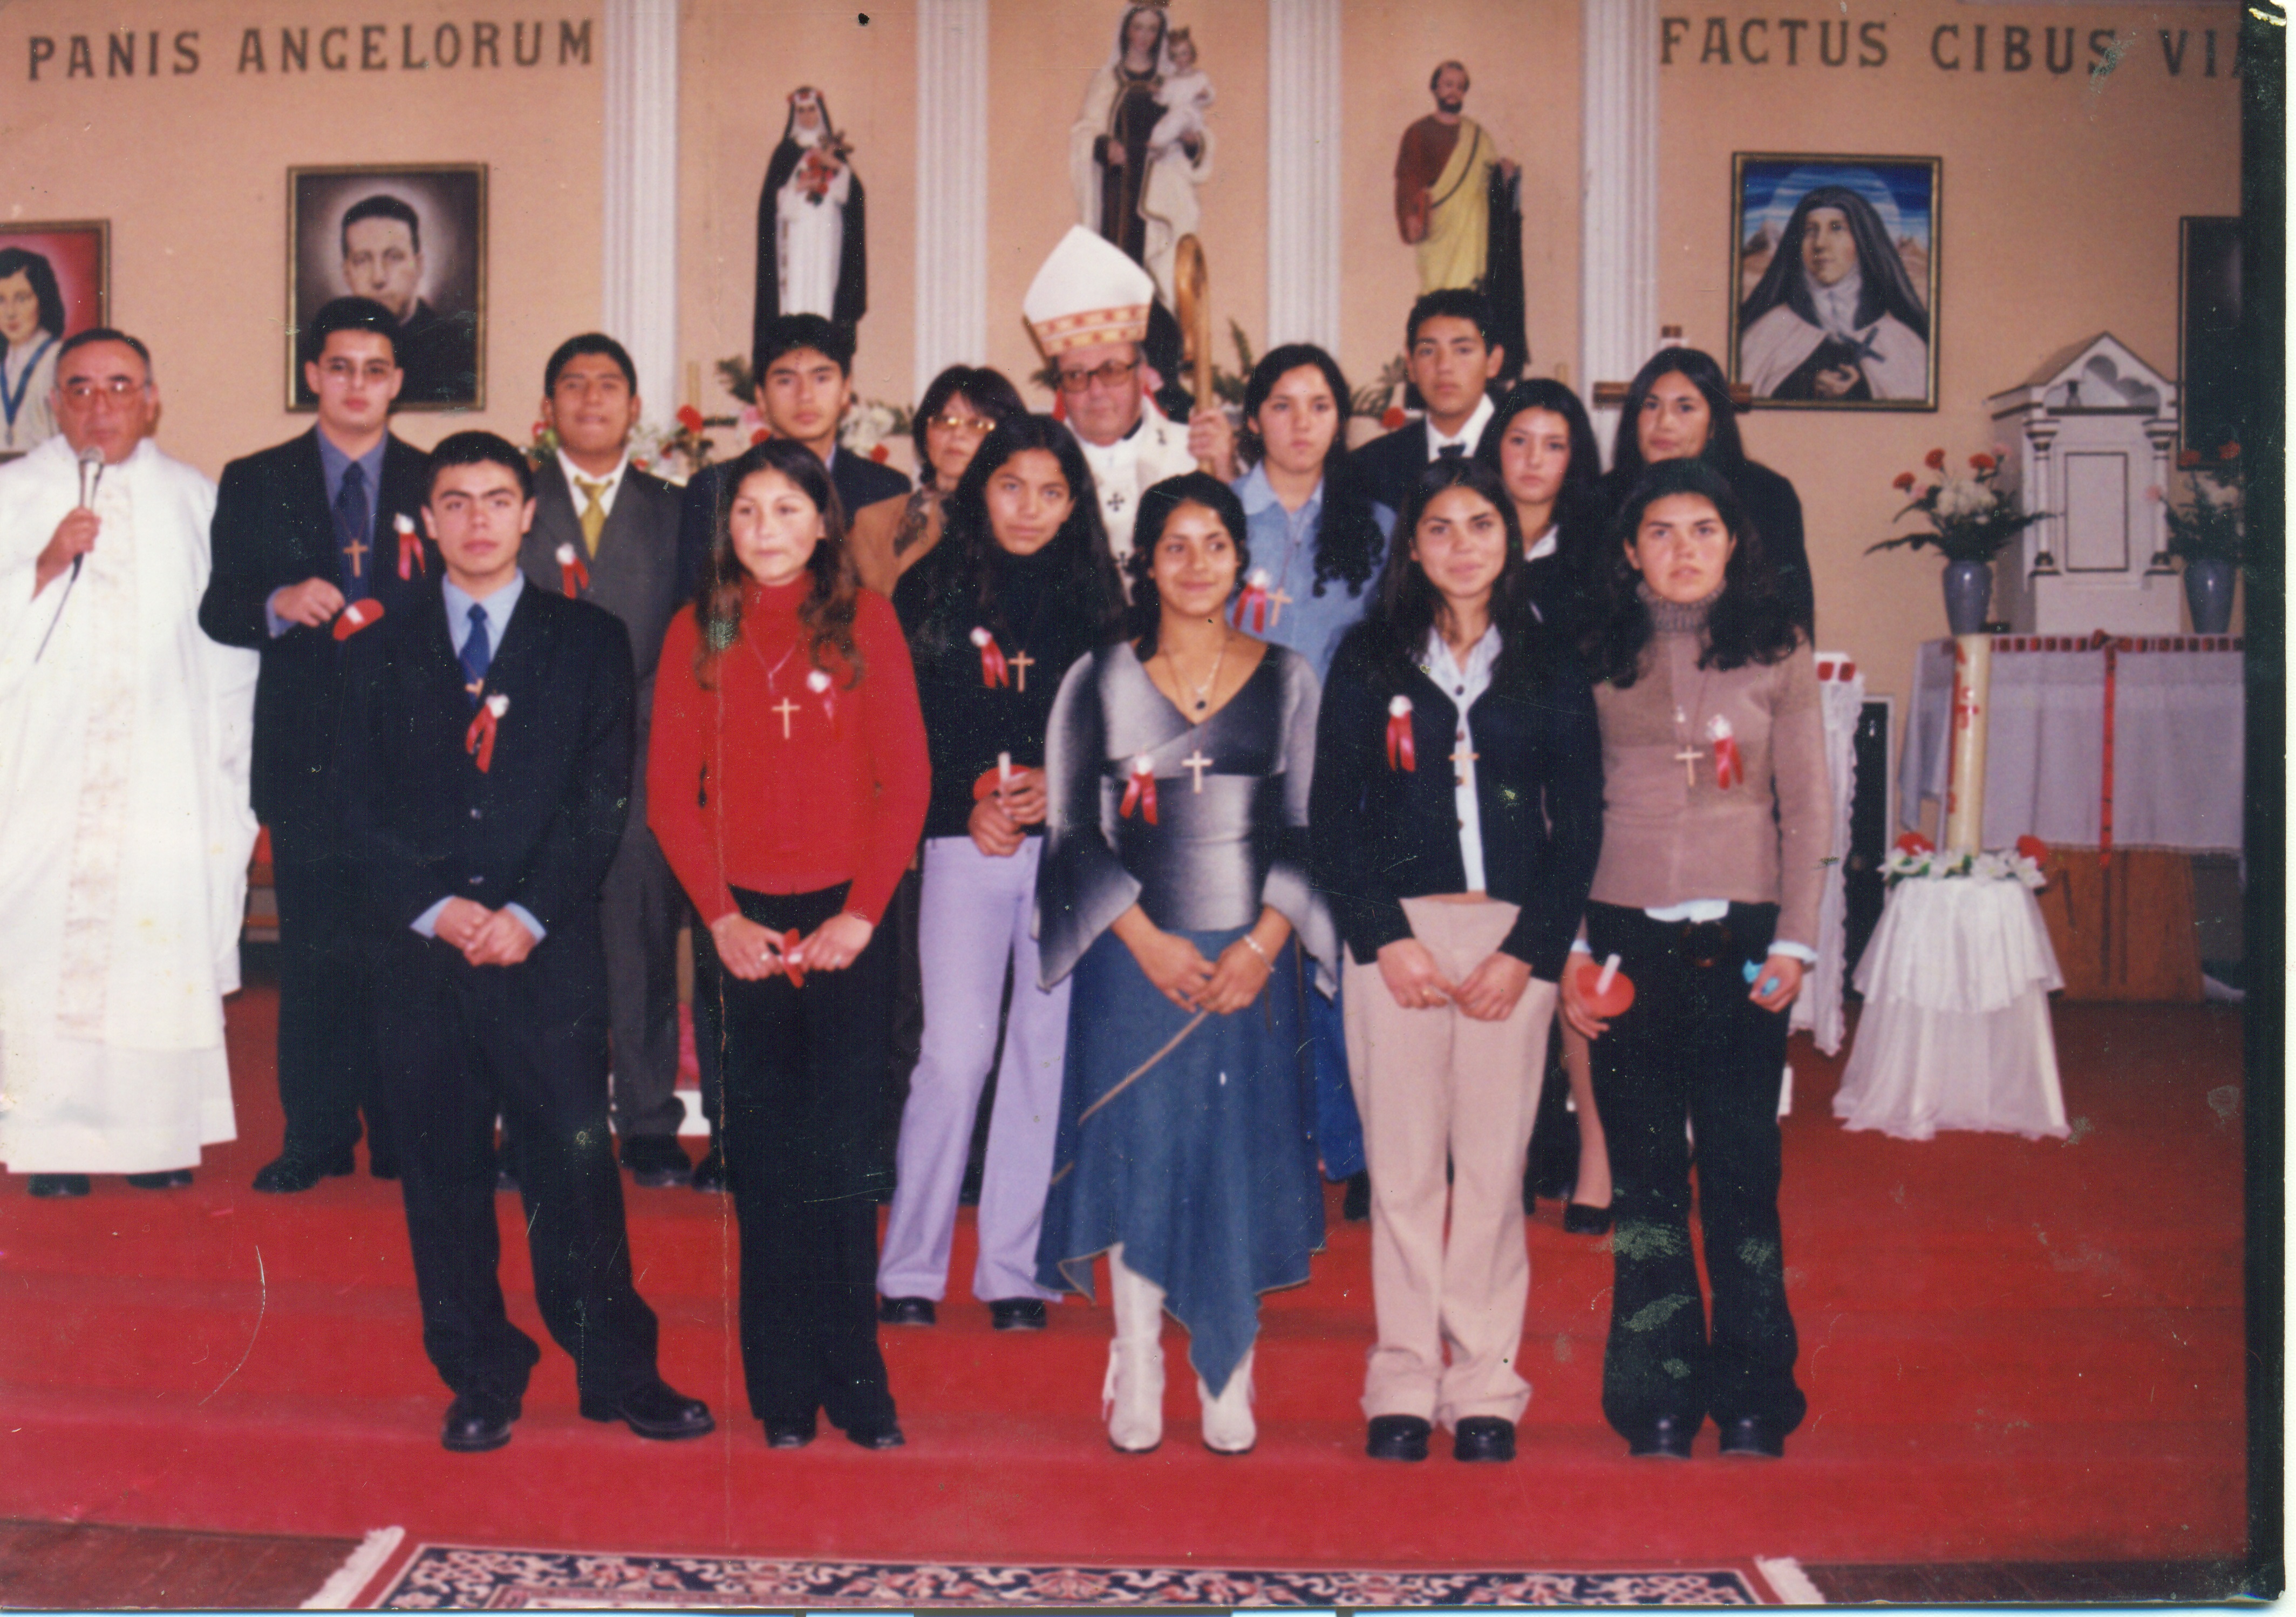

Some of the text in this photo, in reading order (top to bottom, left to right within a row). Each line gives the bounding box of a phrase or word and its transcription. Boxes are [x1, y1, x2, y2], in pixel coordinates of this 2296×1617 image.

[29, 19, 592, 80] PANIS ANGELORUM
[1660, 18, 2242, 78] FACTUS CIBUS VI
